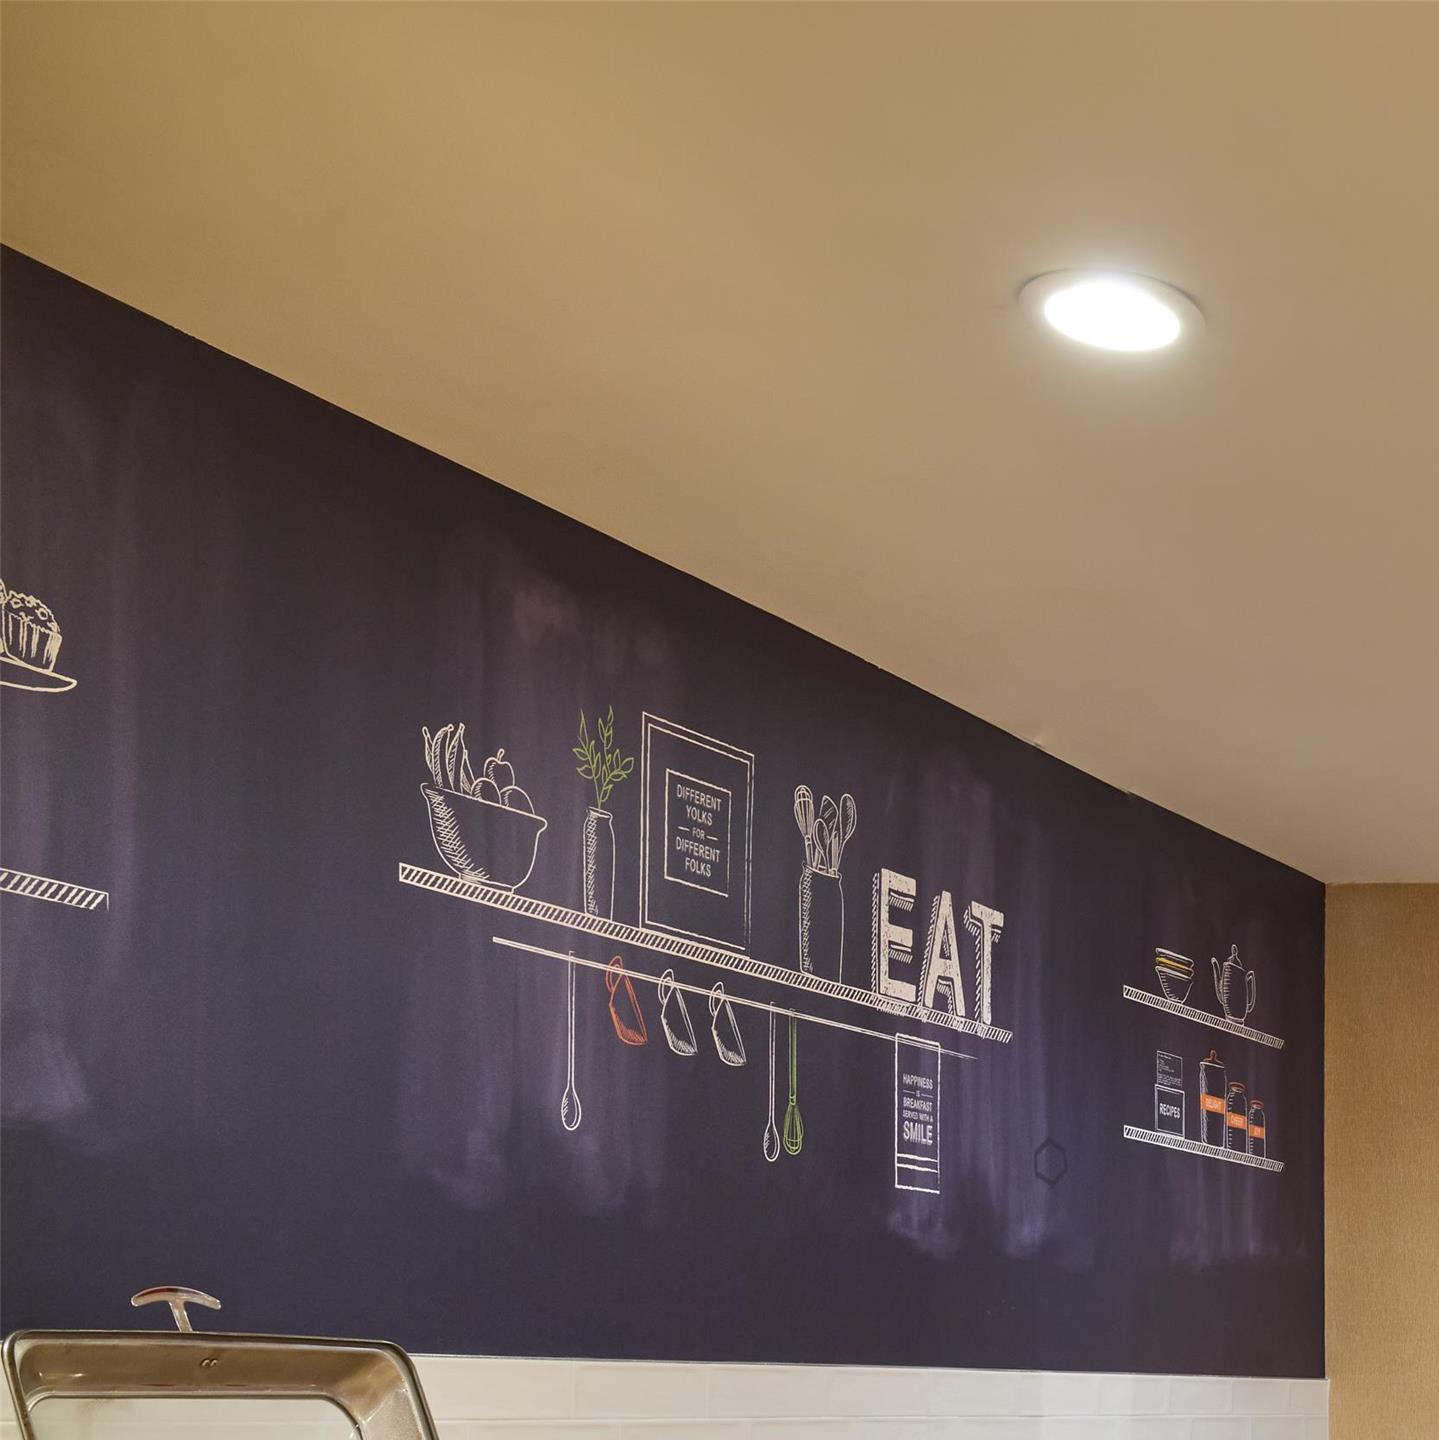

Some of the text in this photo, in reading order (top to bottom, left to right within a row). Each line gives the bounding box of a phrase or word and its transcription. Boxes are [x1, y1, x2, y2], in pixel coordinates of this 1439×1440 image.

[677, 784, 721, 812] DIFFERENT
[686, 804, 712, 826] YOLKS
[692, 827, 705, 840] FOR
[676, 836, 720, 863] DIFFERENT
[685, 858, 712, 878] FOLKS
[872, 868, 1004, 1026] EAT
[902, 1073, 933, 1090] HAPPINESS
[903, 1096, 932, 1112] BREAKFAST
[1160, 1102, 1180, 1119] RECIPES
[904, 1120, 933, 1146] SMILE
